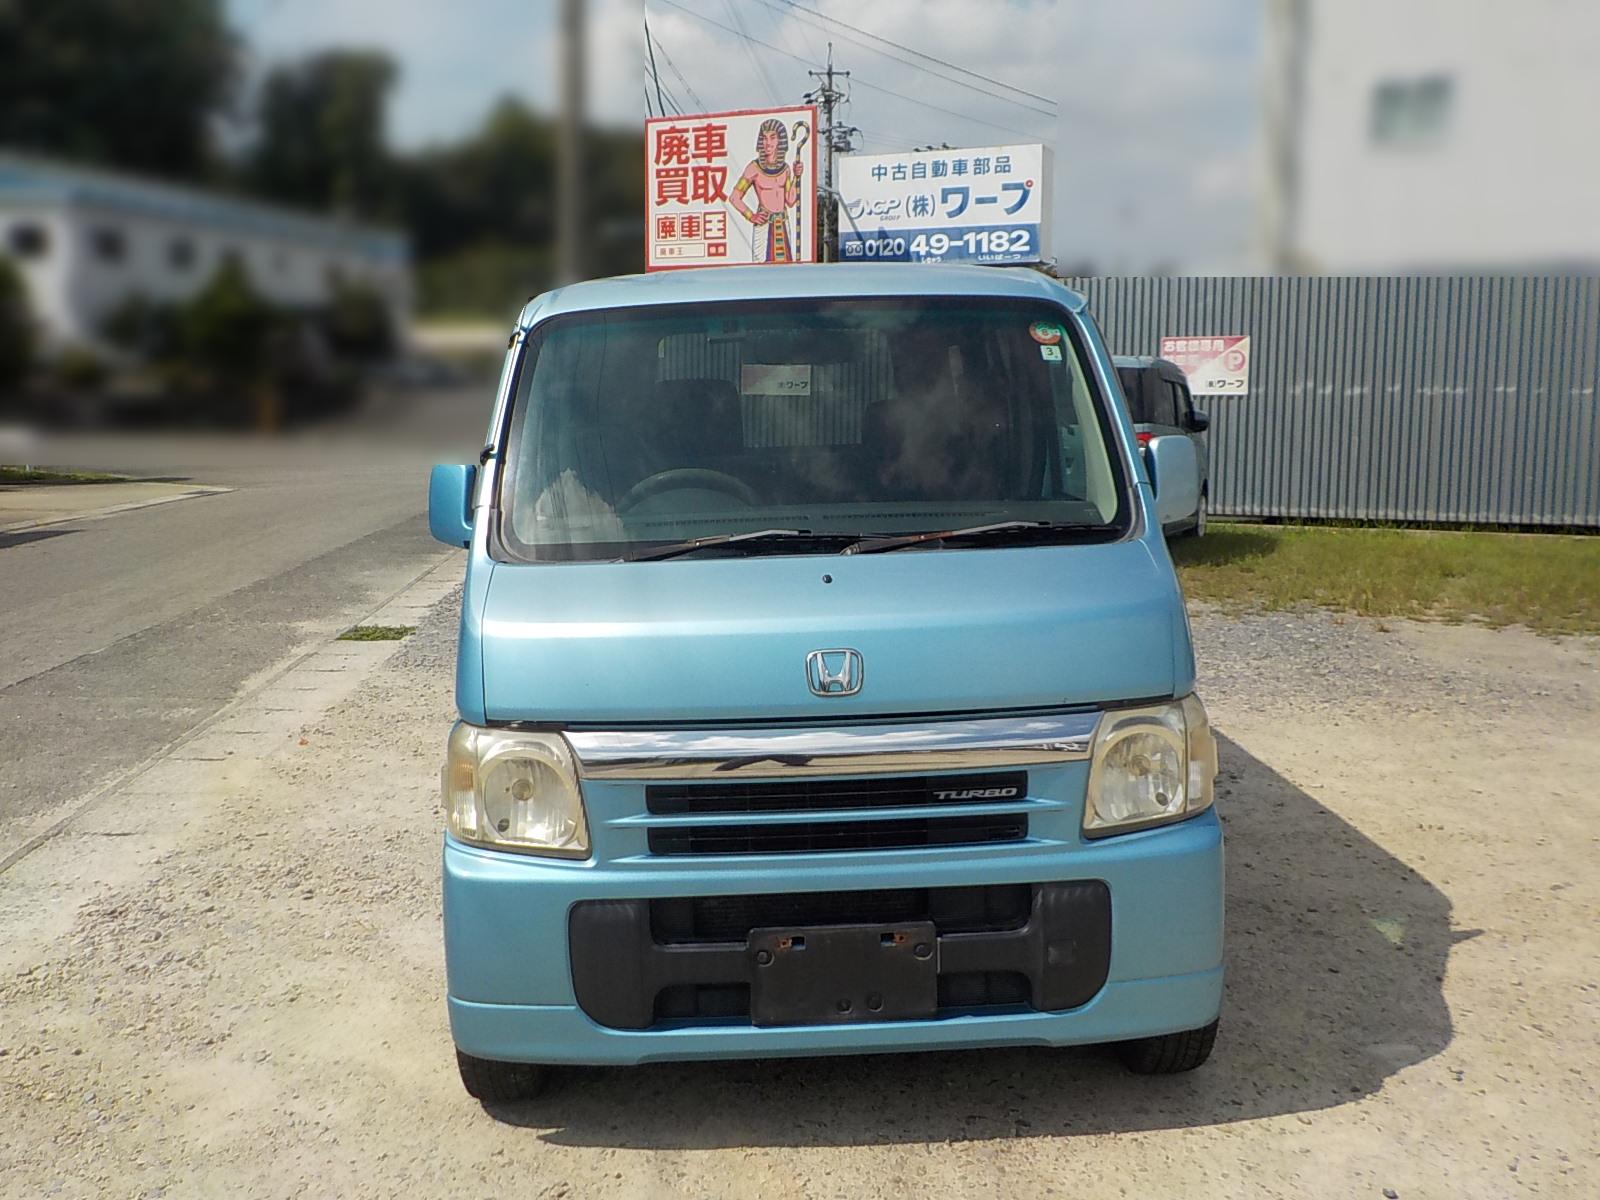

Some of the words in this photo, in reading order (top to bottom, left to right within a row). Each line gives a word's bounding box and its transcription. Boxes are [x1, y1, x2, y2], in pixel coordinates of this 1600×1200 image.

[654, 123, 728, 166] 廃車
[871, 155, 1012, 182] 中古自動車部品
[655, 165, 729, 207] 買取
[865, 239, 905, 257] 0120
[910, 229, 1031, 257] 49-1182
[1046, 347, 1054, 356] 3
[933, 787, 1018, 800] TURBO
